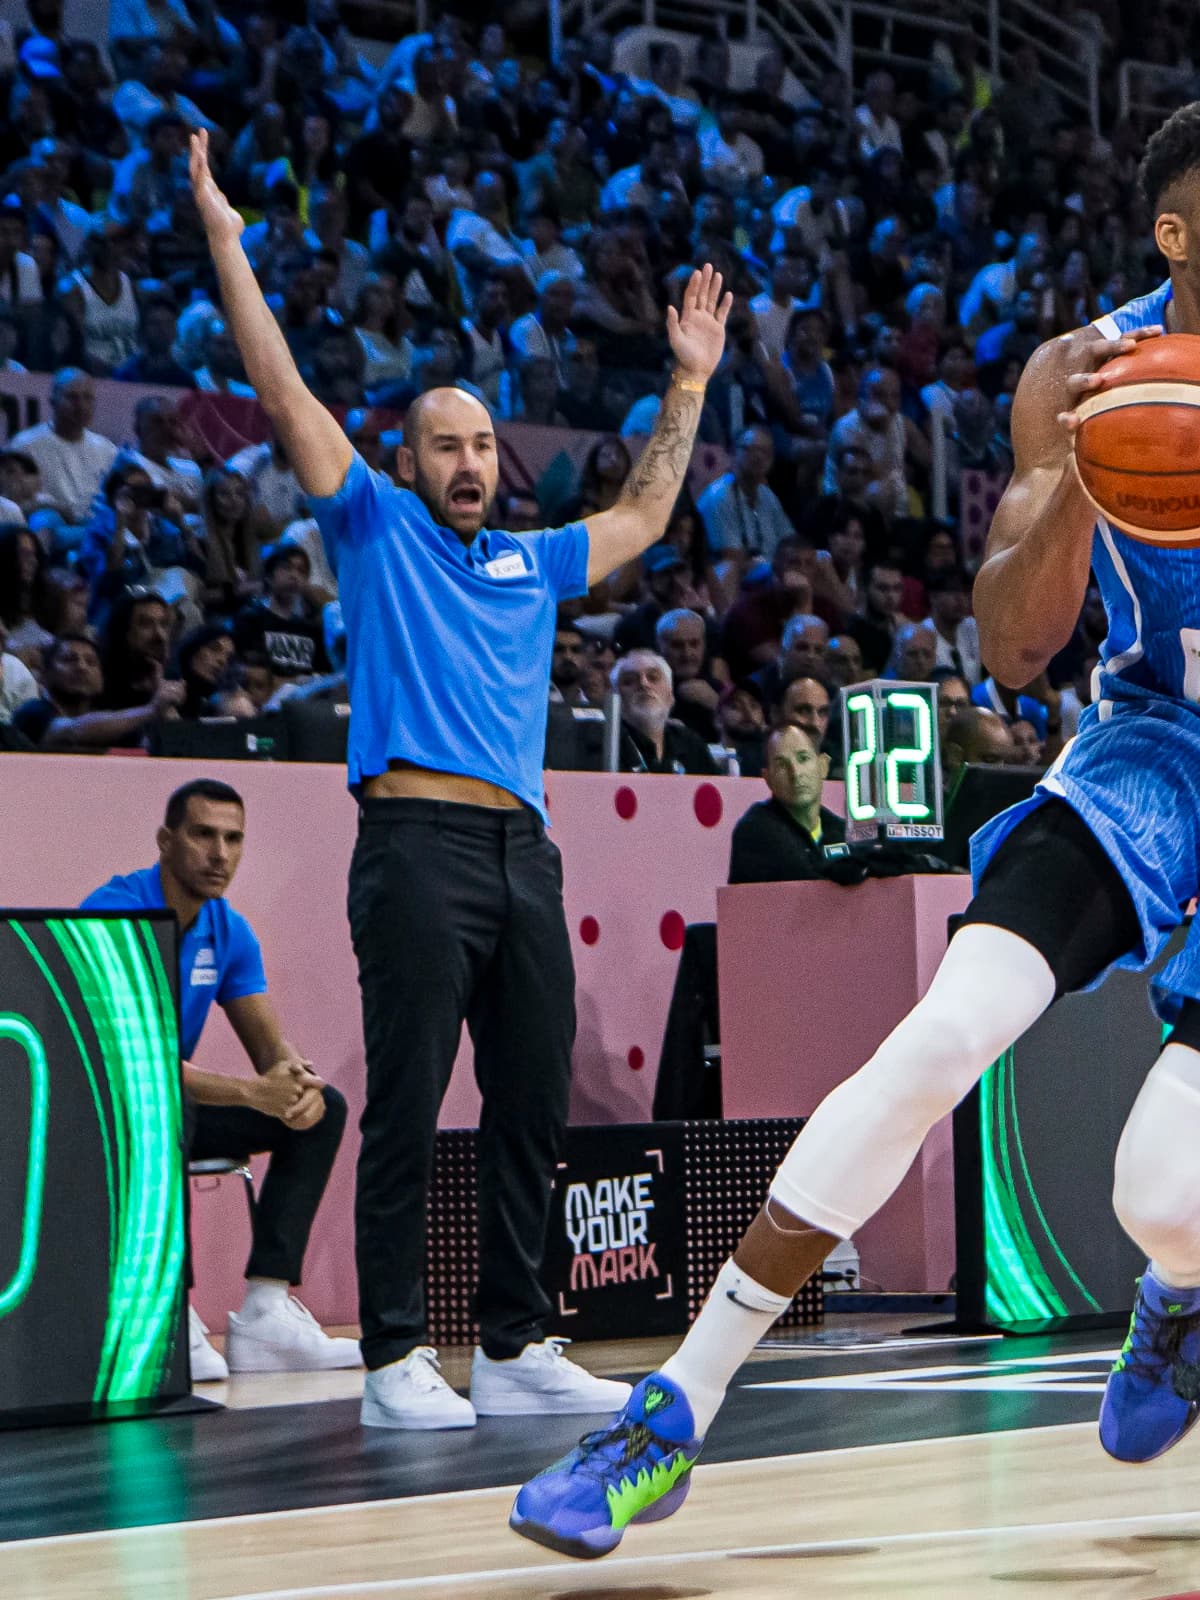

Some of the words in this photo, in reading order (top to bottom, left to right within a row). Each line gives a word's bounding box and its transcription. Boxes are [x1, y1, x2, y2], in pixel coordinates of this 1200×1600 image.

[904, 826, 942, 837] TISSOT
[565, 1173, 655, 1220] MAKE
[566, 1210, 649, 1254] YOUR
[570, 1243, 660, 1291] MARK
